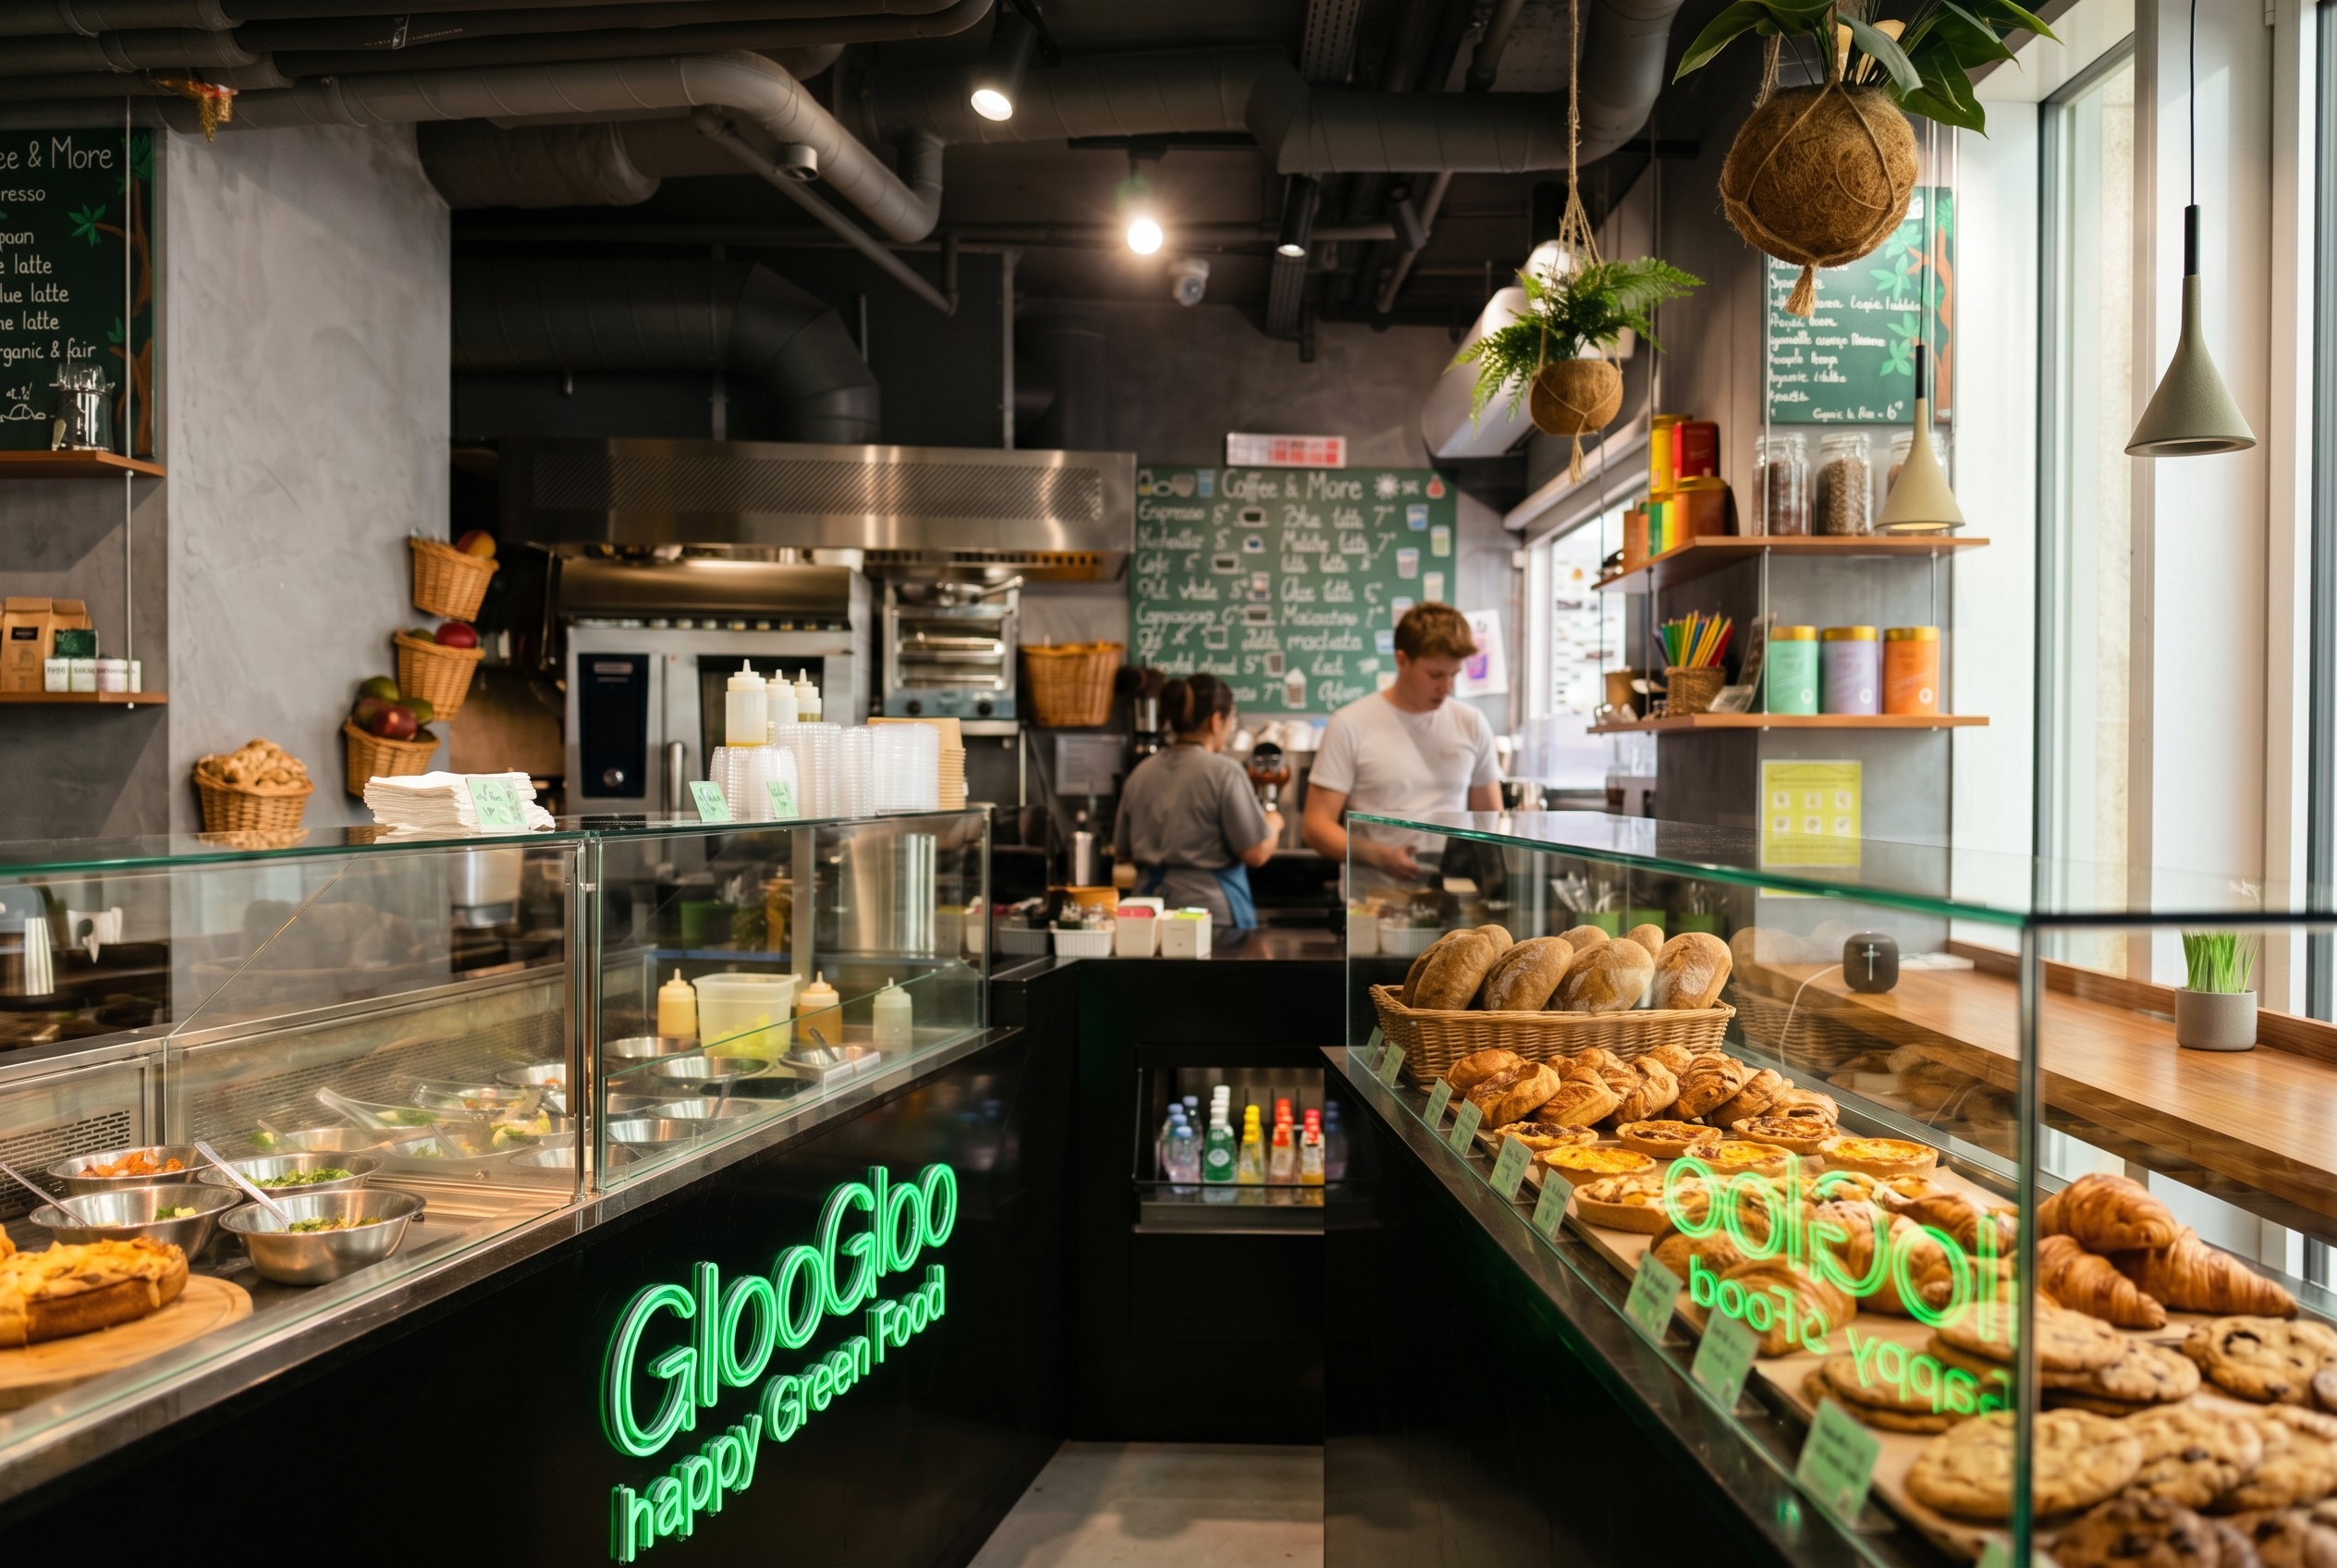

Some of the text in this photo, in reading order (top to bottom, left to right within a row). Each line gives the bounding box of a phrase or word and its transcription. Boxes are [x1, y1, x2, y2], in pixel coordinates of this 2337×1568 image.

[28, 140, 43, 167] &
[51, 135, 114, 169] More
[1, 189, 46, 202] resso
[14, 252, 52, 275] latte
[31, 282, 70, 302] latte
[22, 310, 61, 330] latte
[50, 340, 61, 358] &
[67, 337, 97, 364] fair
[1221, 468, 1279, 503] Coffee
[1306, 471, 1364, 501] More
[600, 1163, 958, 1457] GlooGloo
[610, 1264, 946, 1564] happy Green Food
